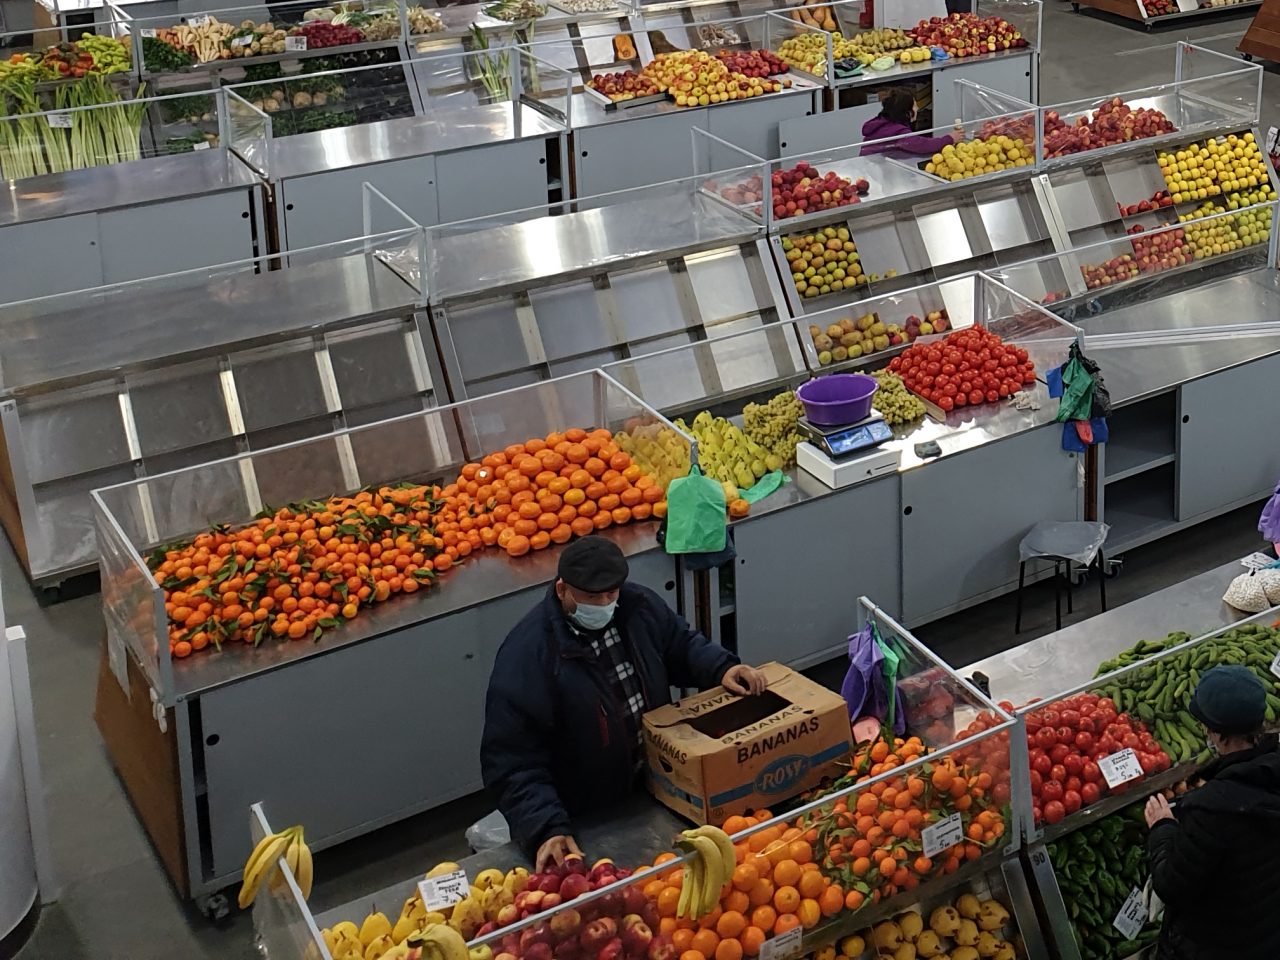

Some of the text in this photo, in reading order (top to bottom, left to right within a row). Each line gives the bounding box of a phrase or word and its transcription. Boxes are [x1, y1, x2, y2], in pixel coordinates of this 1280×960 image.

[722, 703, 803, 745] BANANAS
[736, 717, 820, 764] BANANAS
[1033, 852, 1046, 867] 90
